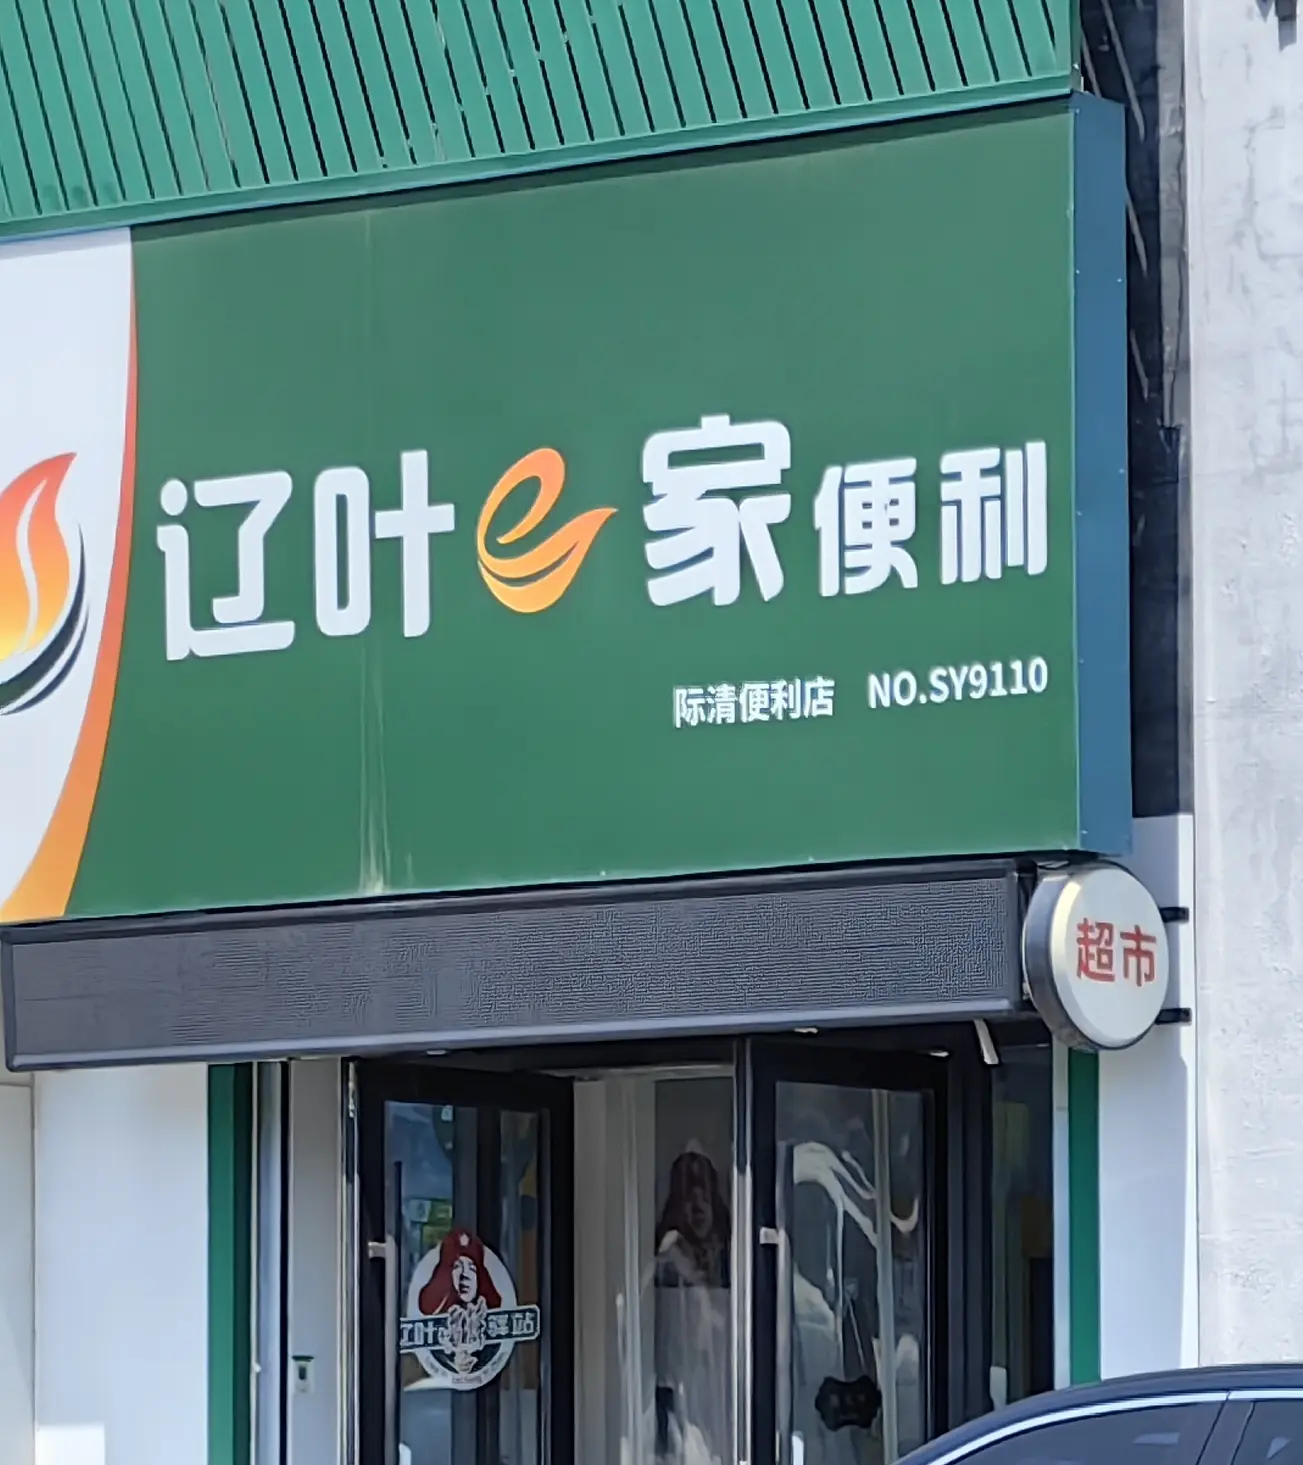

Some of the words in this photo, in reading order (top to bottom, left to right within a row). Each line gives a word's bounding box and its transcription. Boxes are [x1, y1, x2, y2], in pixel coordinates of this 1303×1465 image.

[674, 675, 836, 728] 际清便利店
[866, 655, 1049, 709] NO.SY9110
[1076, 917, 1157, 988] 超市
